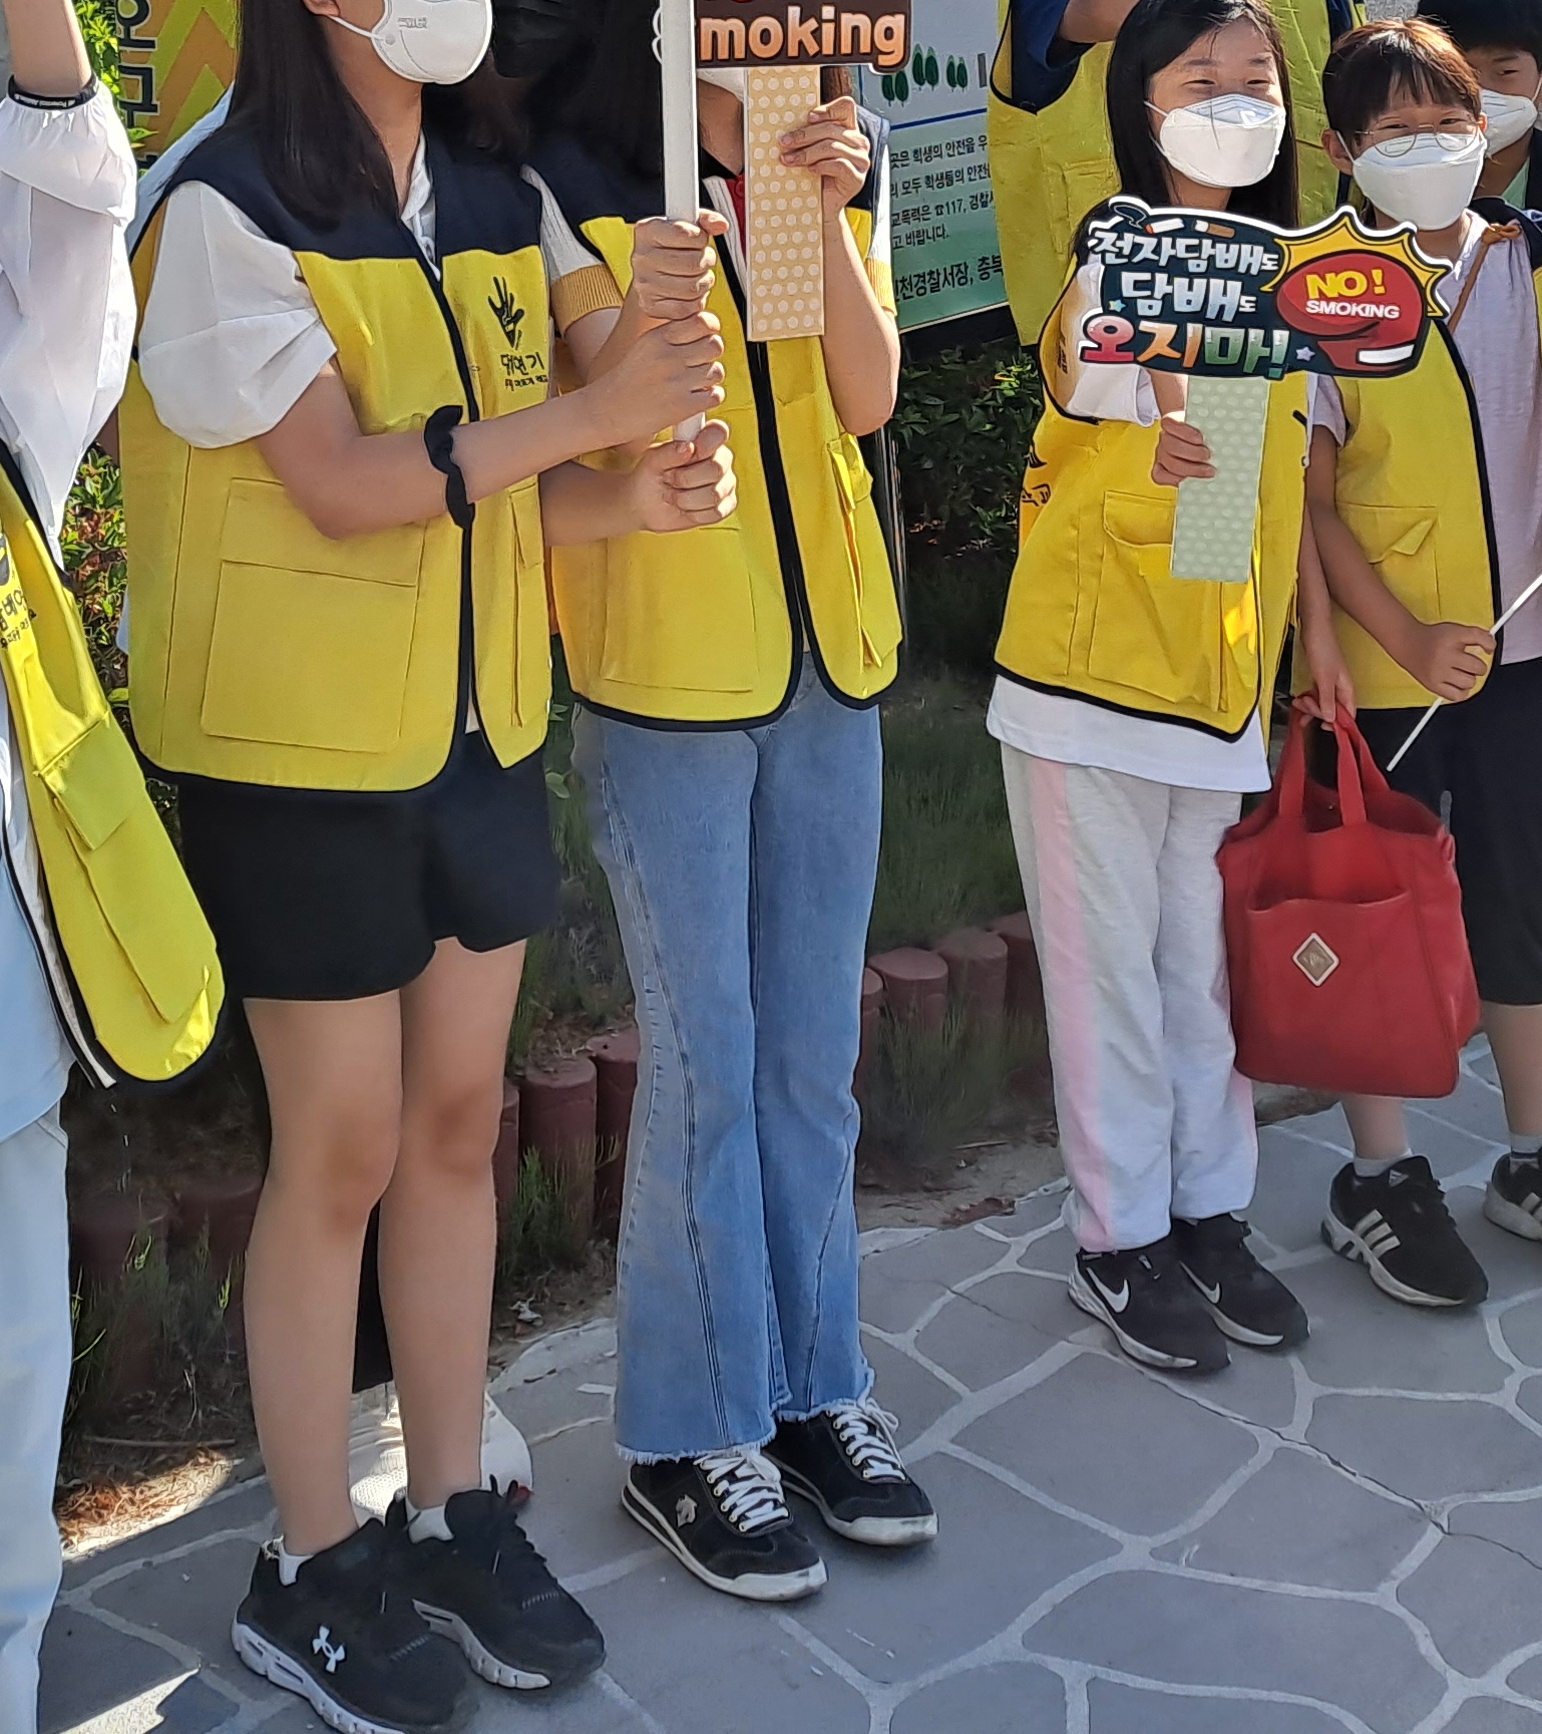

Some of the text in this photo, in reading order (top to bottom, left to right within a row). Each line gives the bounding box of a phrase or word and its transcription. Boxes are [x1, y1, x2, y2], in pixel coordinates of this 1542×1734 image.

[693, 4, 906, 67] moking
[945, 136, 975, 157] 안전을
[901, 177, 922, 195] 모두
[924, 167, 965, 191] 학생들의
[1092, 229, 1281, 277] 전자담배도
[1119, 270, 1259, 323] 담배도
[1305, 299, 1401, 320] SMOKING
[1081, 315, 1291, 379] 오지마!
